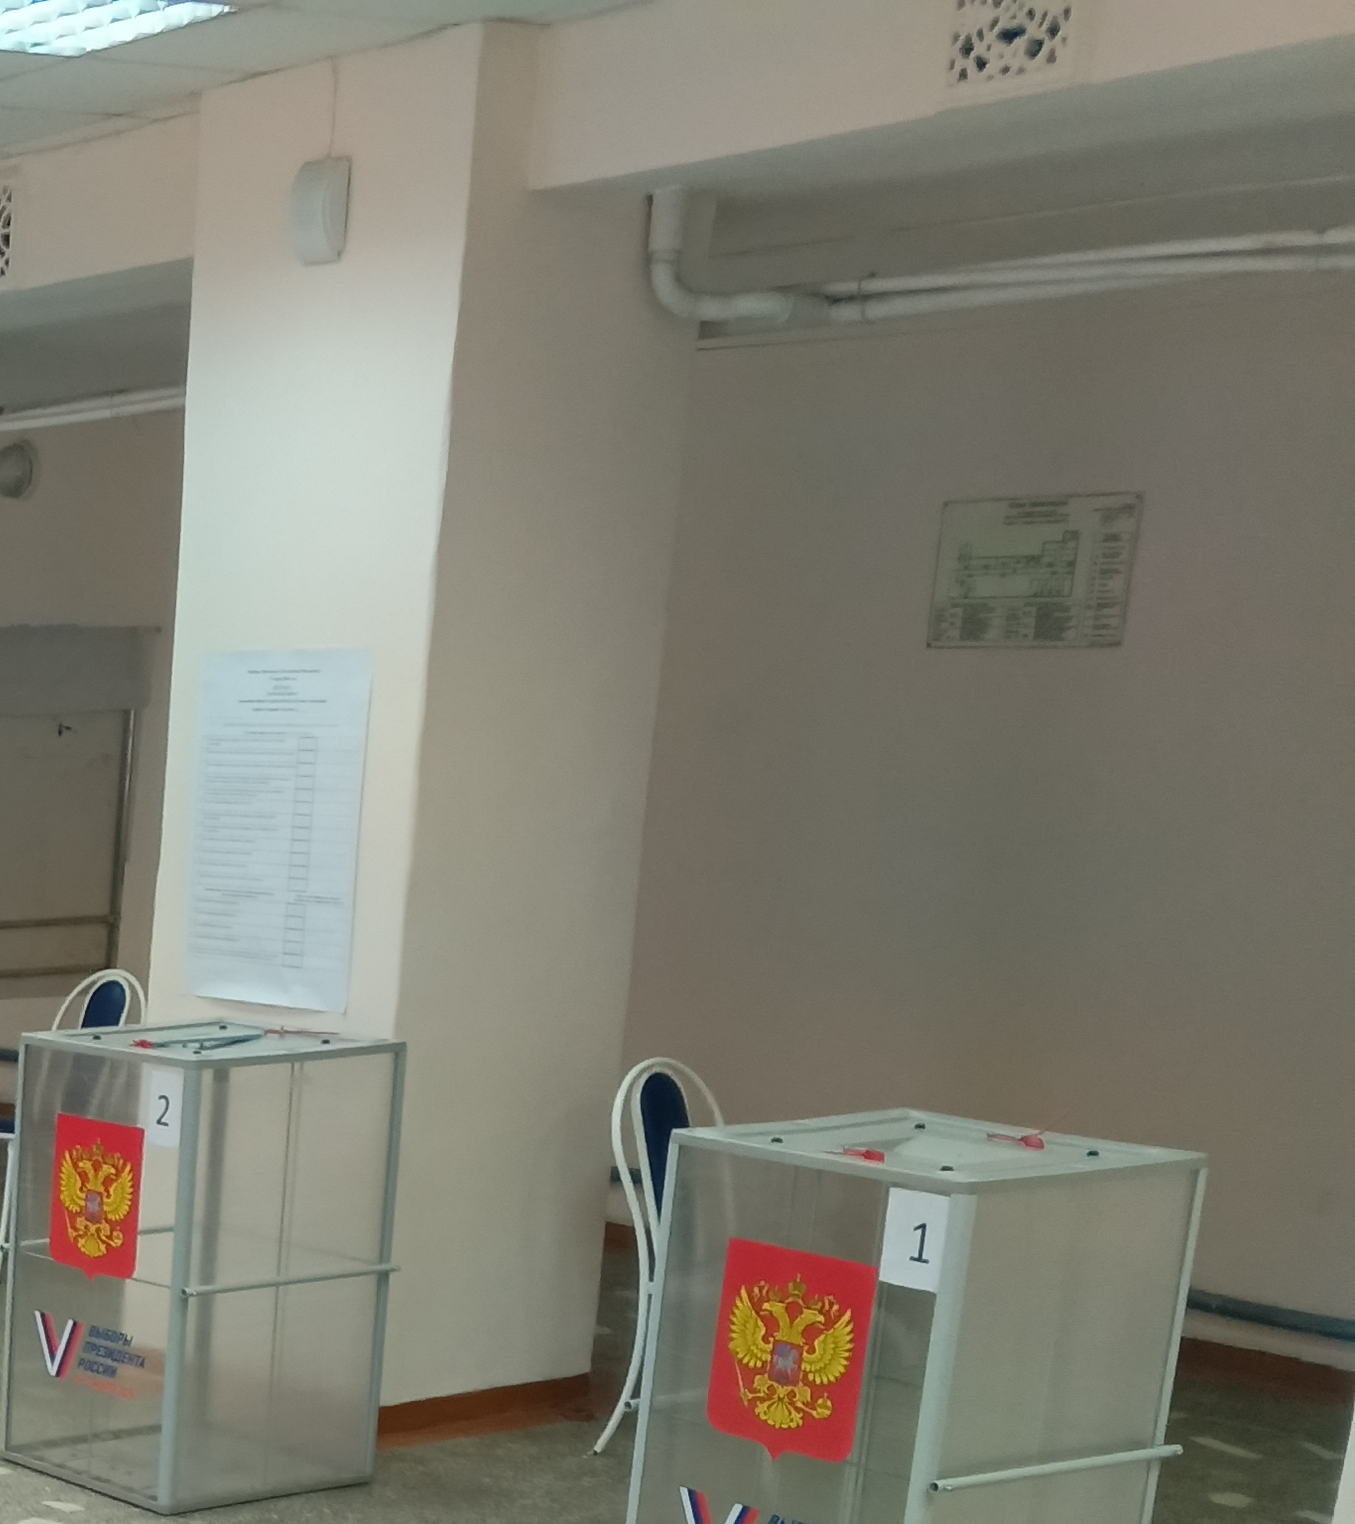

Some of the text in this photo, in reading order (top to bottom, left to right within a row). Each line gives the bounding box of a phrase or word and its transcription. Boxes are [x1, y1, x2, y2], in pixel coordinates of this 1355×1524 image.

[156, 1095, 170, 1127] 2
[909, 1223, 929, 1264] 1
[88, 1325, 133, 1346] ВЫБОРЫ
[77, 1358, 118, 1378] РОССИИ
[82, 1341, 146, 1368] ПРЕЗИДЕНТА
